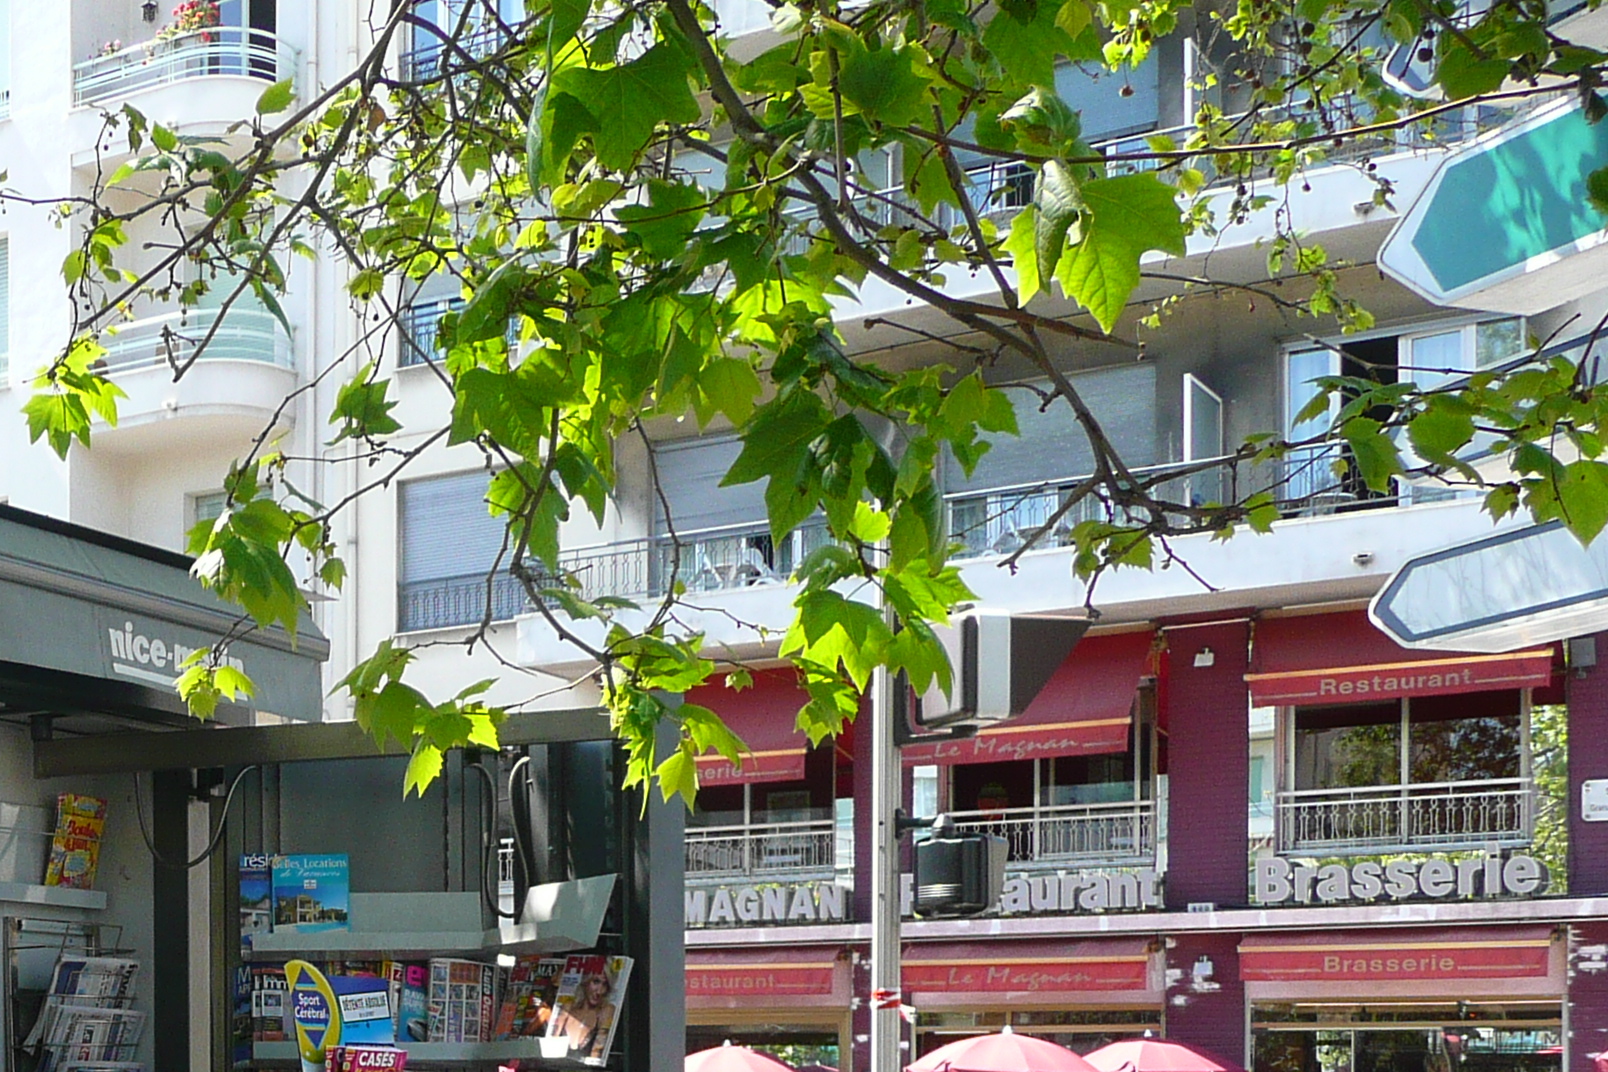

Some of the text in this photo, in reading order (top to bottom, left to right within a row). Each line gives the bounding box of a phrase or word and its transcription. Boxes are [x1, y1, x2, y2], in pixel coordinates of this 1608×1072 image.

[1319, 668, 1475, 697] Restaurant
[933, 736, 1080, 758] Le Magnan
[694, 764, 743, 781] serie
[1254, 841, 1543, 902] Brasserie
[685, 884, 842, 923] MAGNAN
[1323, 954, 1456, 973] Brasserie
[686, 973, 776, 990] staurant
[947, 964, 1092, 989] Le Magnan
[298, 992, 321, 1006] Sport
